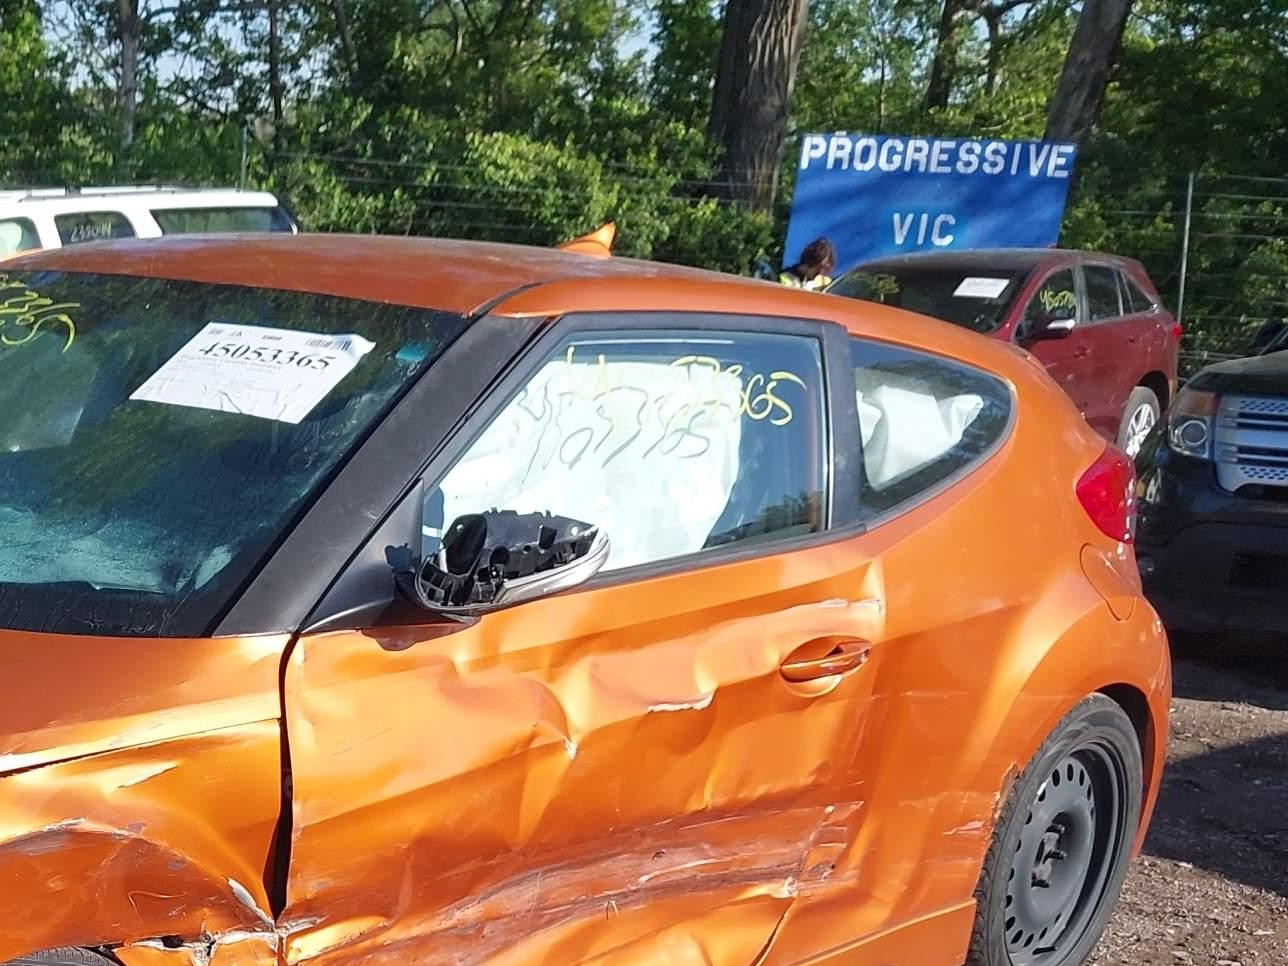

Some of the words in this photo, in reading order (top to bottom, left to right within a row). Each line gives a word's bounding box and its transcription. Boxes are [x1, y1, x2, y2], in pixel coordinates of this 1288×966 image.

[800, 135, 1077, 178] PROGRESSIVE
[892, 212, 957, 247] VIC
[198, 342, 337, 371] 45053365
